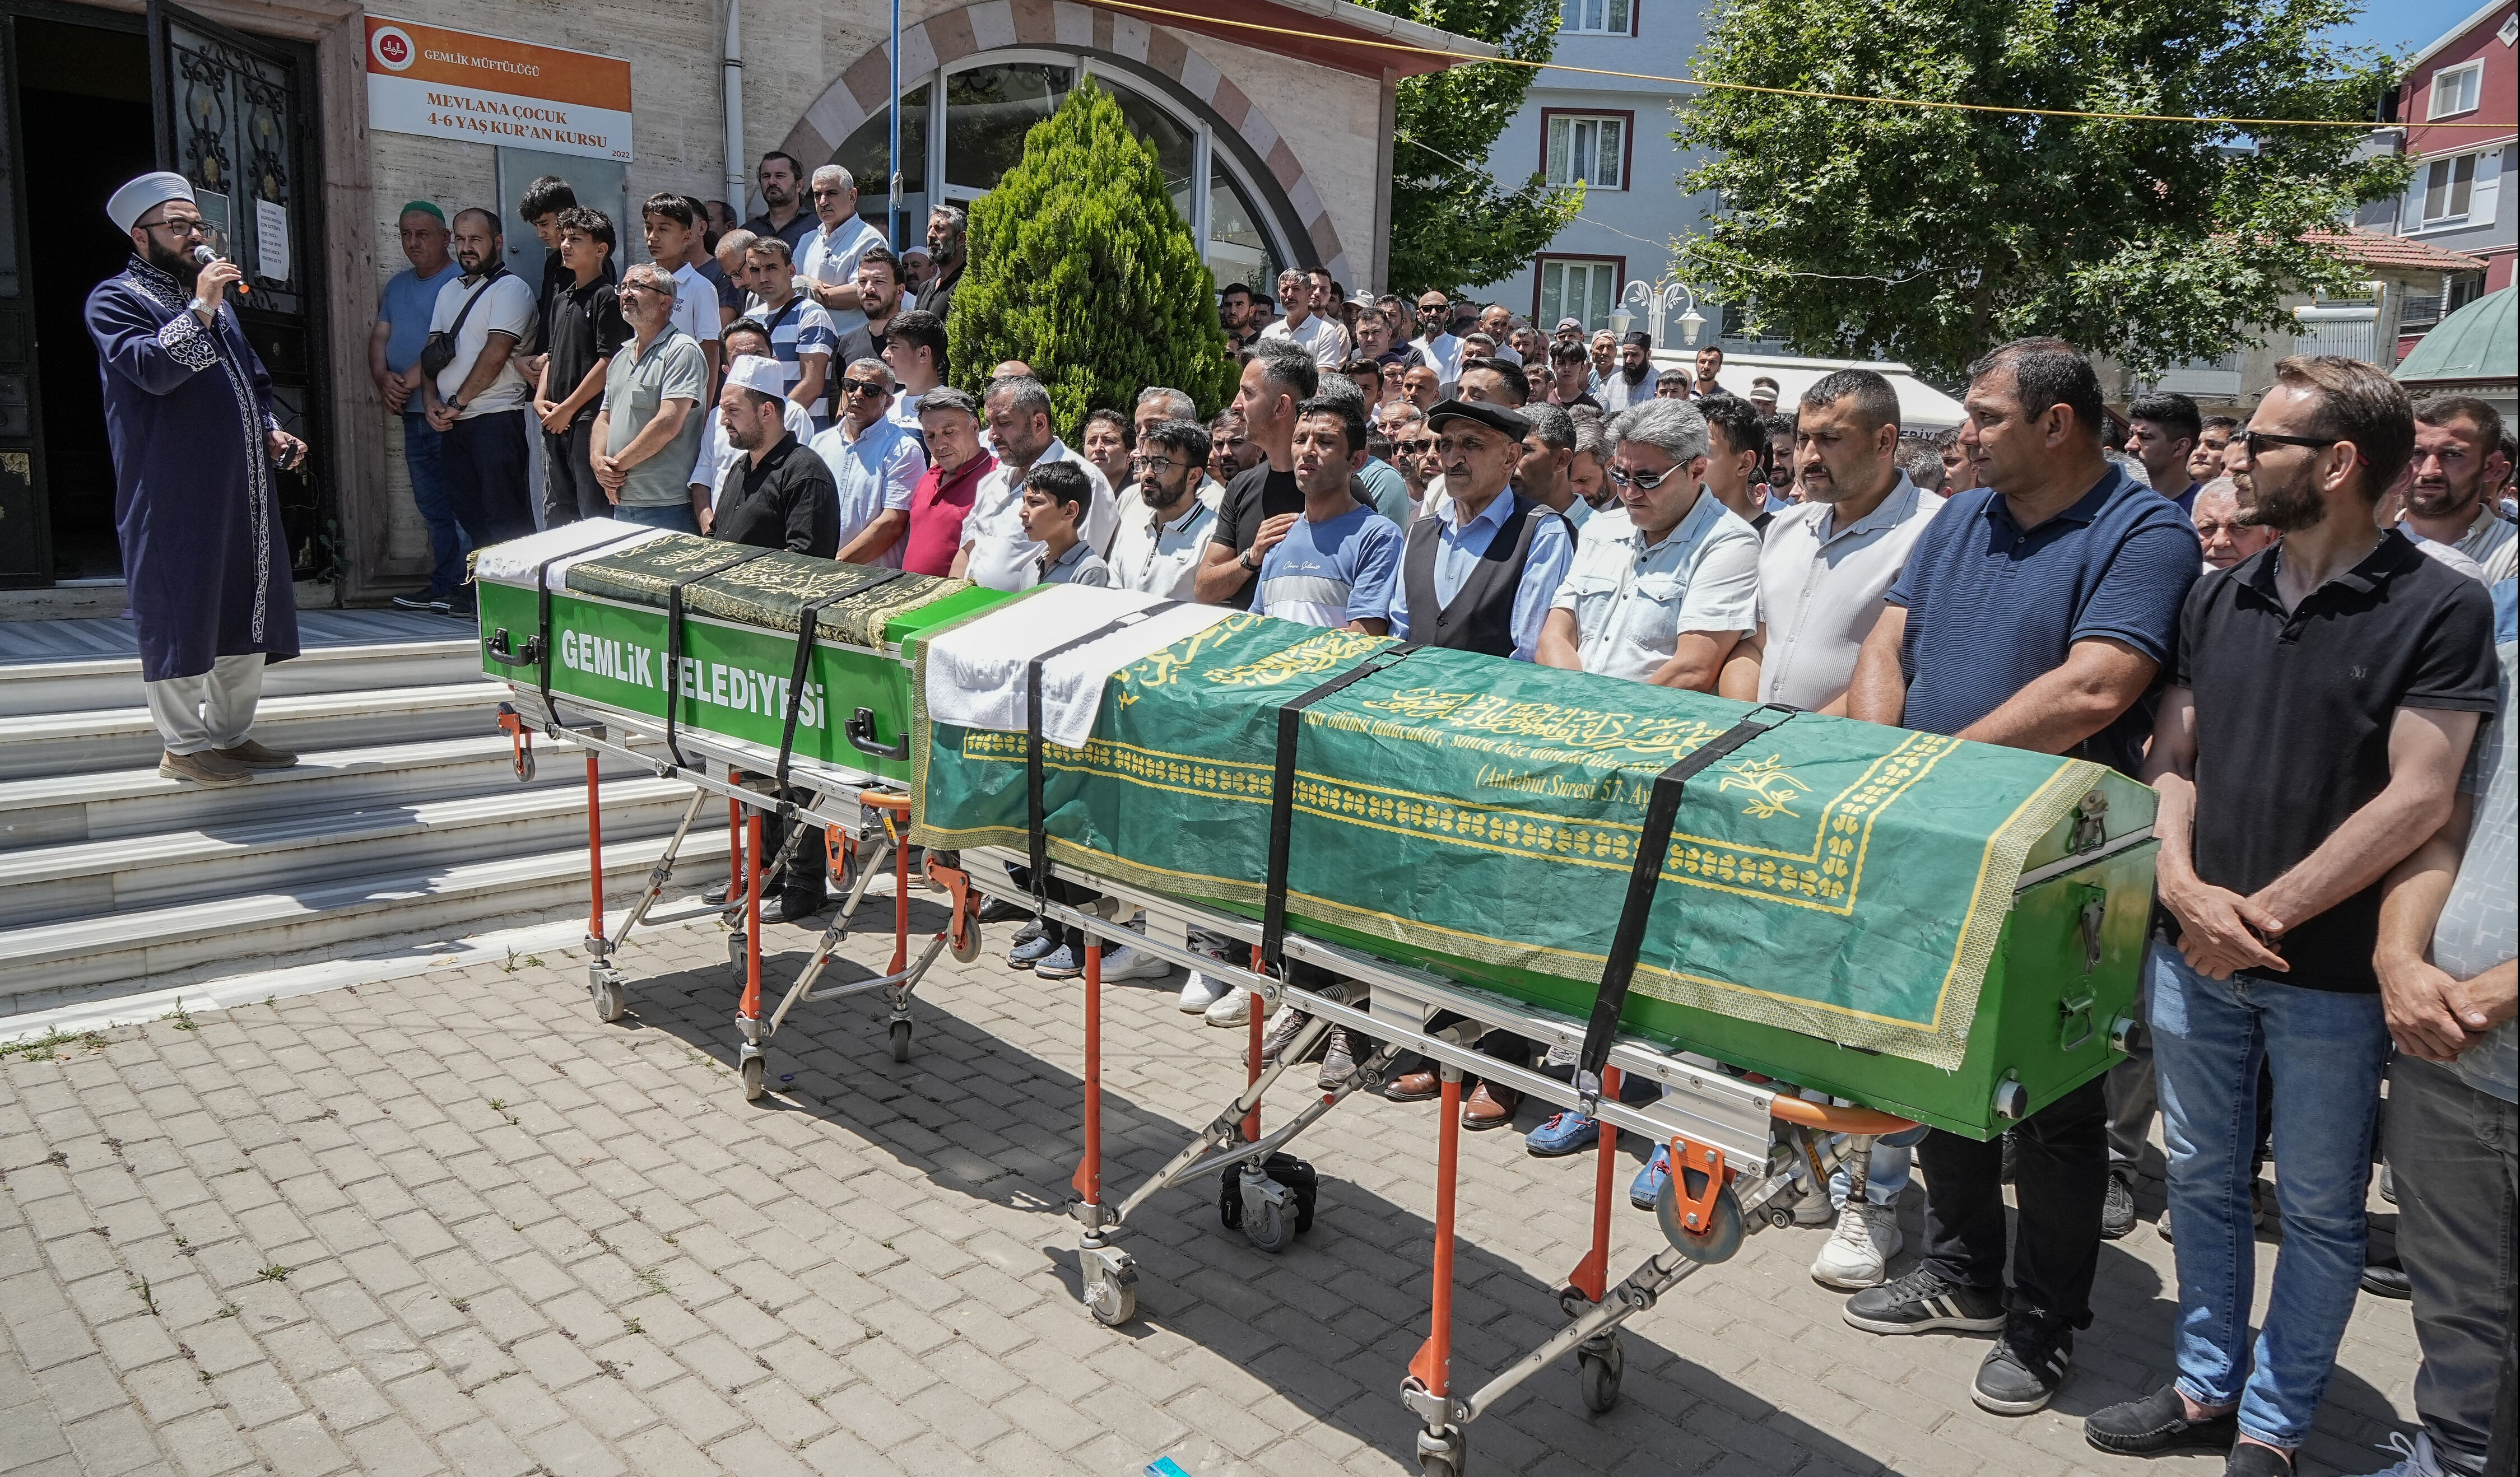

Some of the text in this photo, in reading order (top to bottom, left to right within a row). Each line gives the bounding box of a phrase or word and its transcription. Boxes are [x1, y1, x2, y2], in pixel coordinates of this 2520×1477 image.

[424, 50, 540, 77] GEMLİK MÜFTÜLÜĞÜ
[426, 92, 568, 124] MEVLANA ÇOCUK
[427, 112, 607, 148] 4-6 YAŞ KUR'AN KURSU
[612, 150, 630, 159] 2022
[1304, 710, 1327, 726] can
[1327, 710, 1374, 733] ölümü
[1450, 733, 1497, 752] sonra
[1496, 739, 1531, 758] bize
[1547, 773, 1597, 800] Suresi
[1600, 779, 1624, 803] 57.
